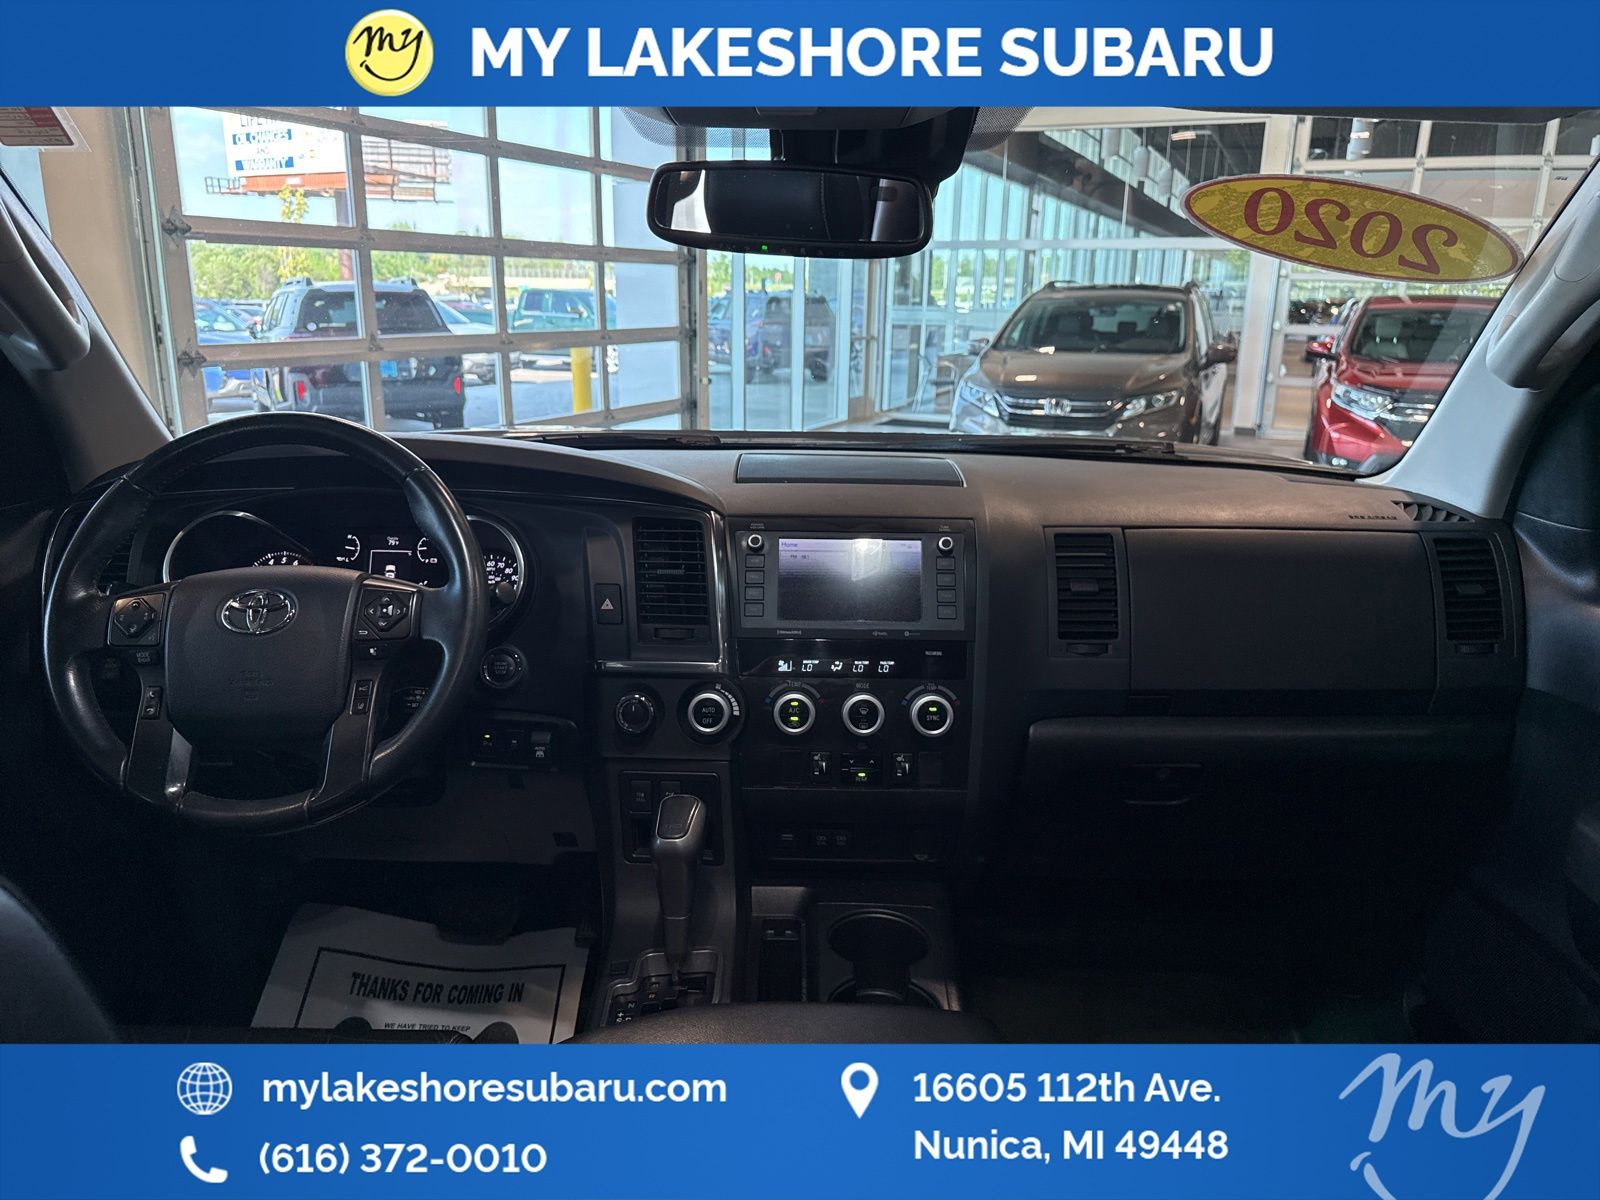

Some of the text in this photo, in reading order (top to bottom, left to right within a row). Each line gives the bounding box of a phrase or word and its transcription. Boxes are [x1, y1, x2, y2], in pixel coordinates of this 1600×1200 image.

[350, 972, 525, 1005] THANKS FOR COMING IN
